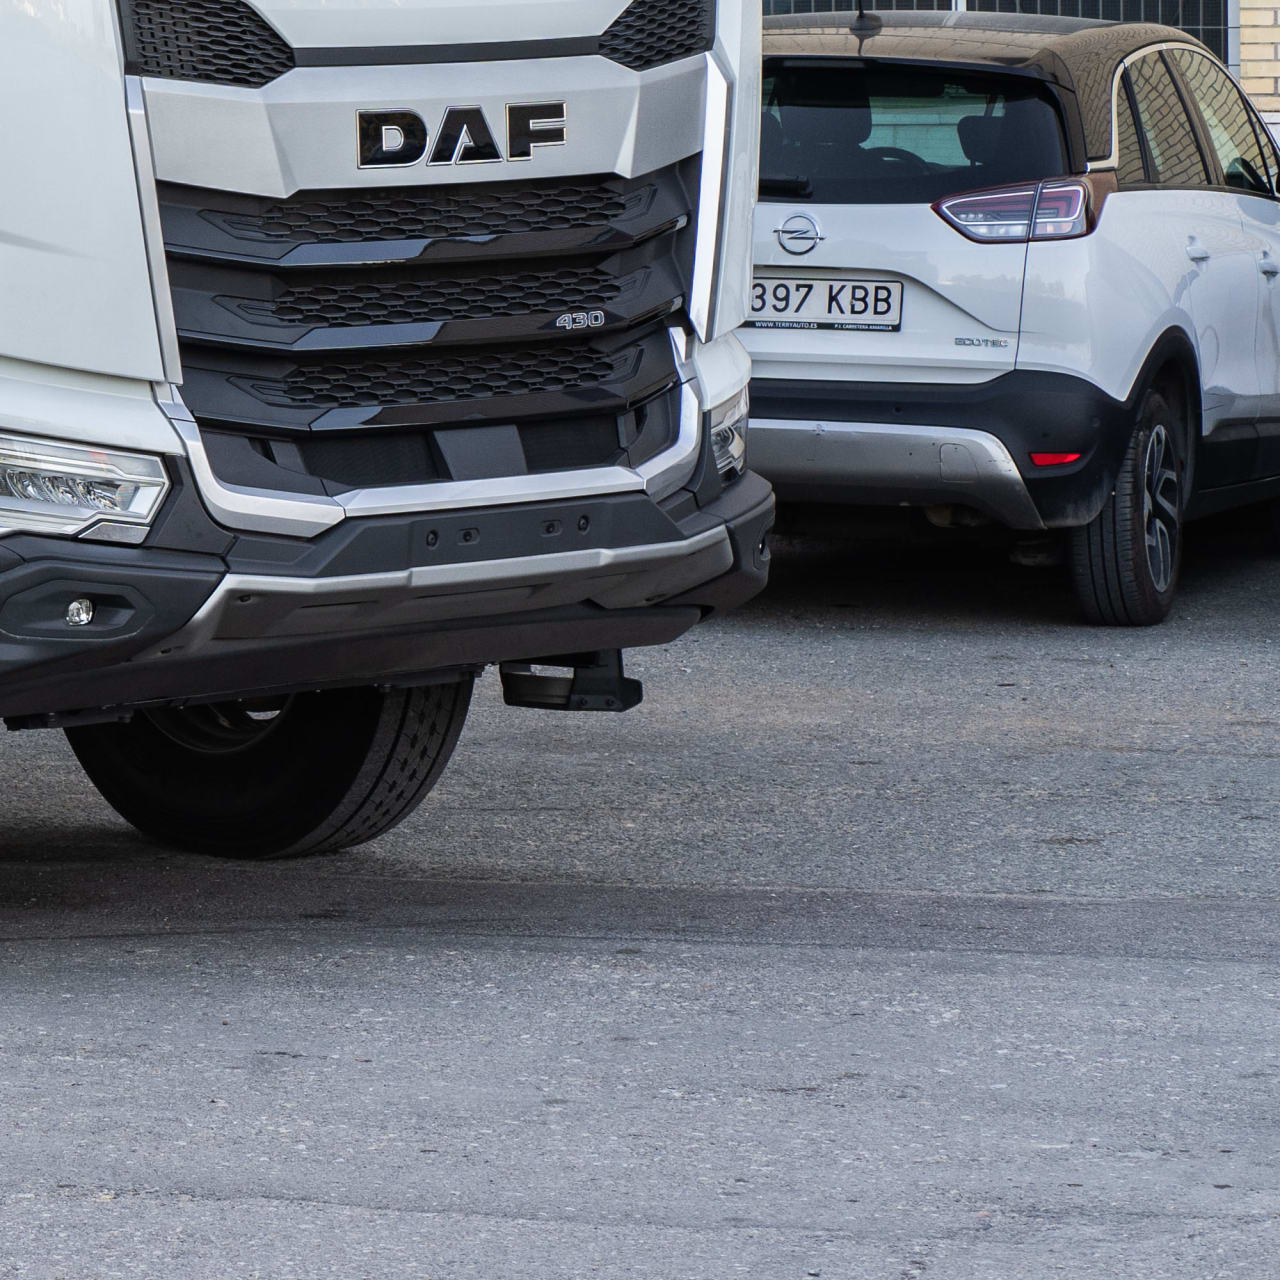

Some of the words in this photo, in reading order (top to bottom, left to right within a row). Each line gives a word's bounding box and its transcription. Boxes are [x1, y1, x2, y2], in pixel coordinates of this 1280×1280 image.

[356, 100, 566, 169] DAF
[751, 282, 813, 313] 397
[827, 284, 892, 315] KBB
[556, 310, 605, 330] 430
